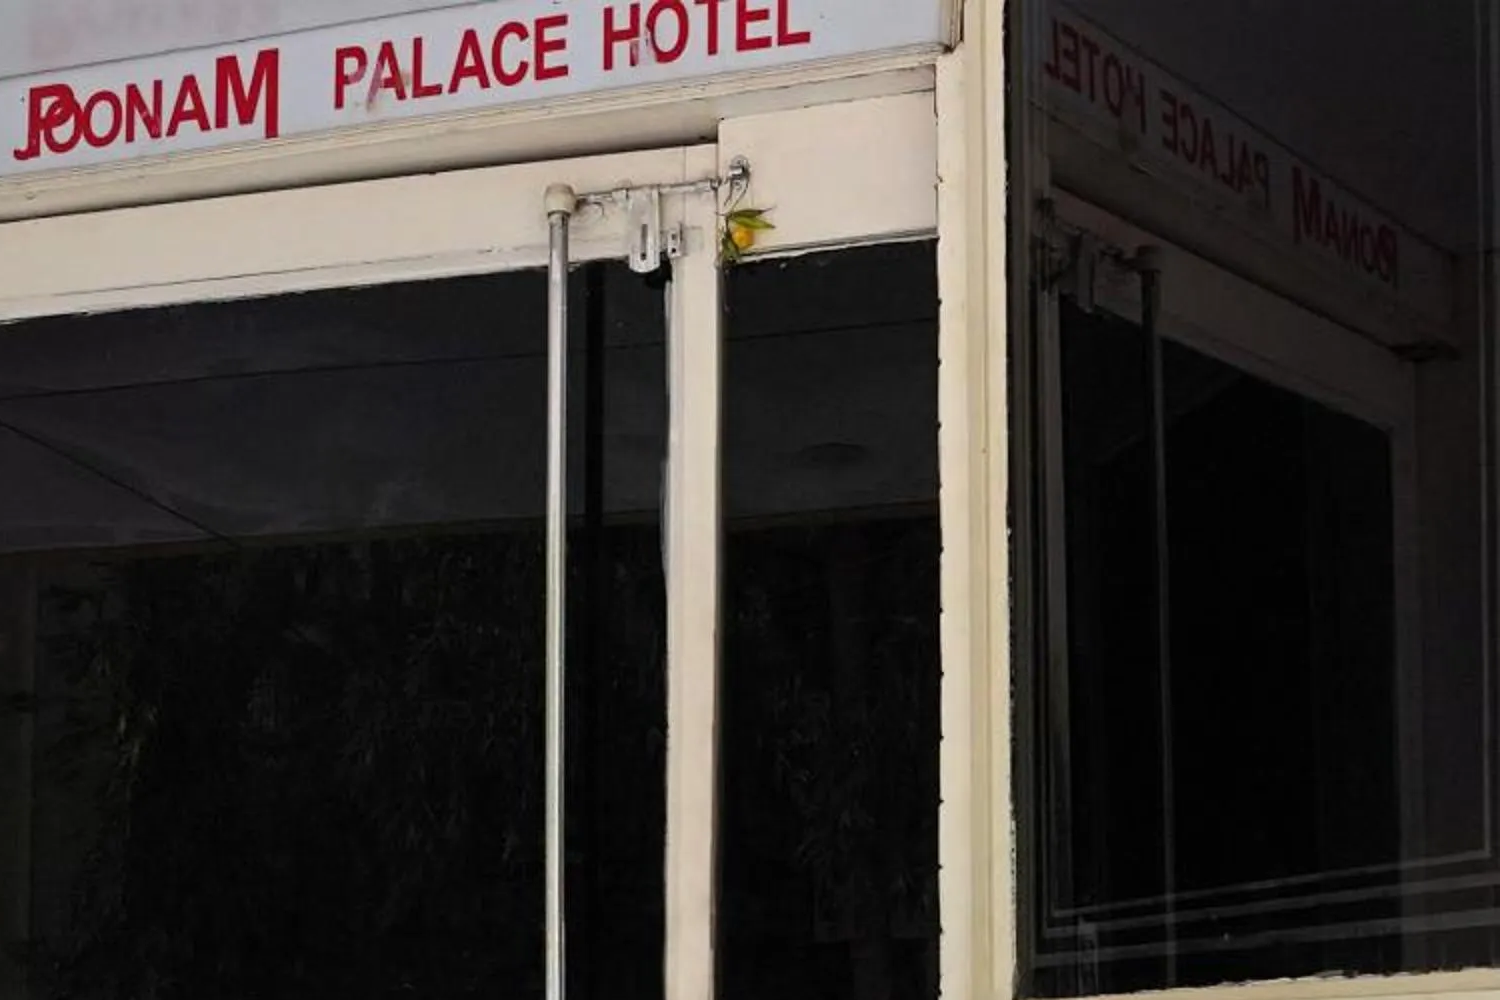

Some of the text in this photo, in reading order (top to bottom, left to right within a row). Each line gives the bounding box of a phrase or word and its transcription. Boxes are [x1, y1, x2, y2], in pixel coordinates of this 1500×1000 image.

[14, 0, 811, 160] POONAM PALACE HOTEL
